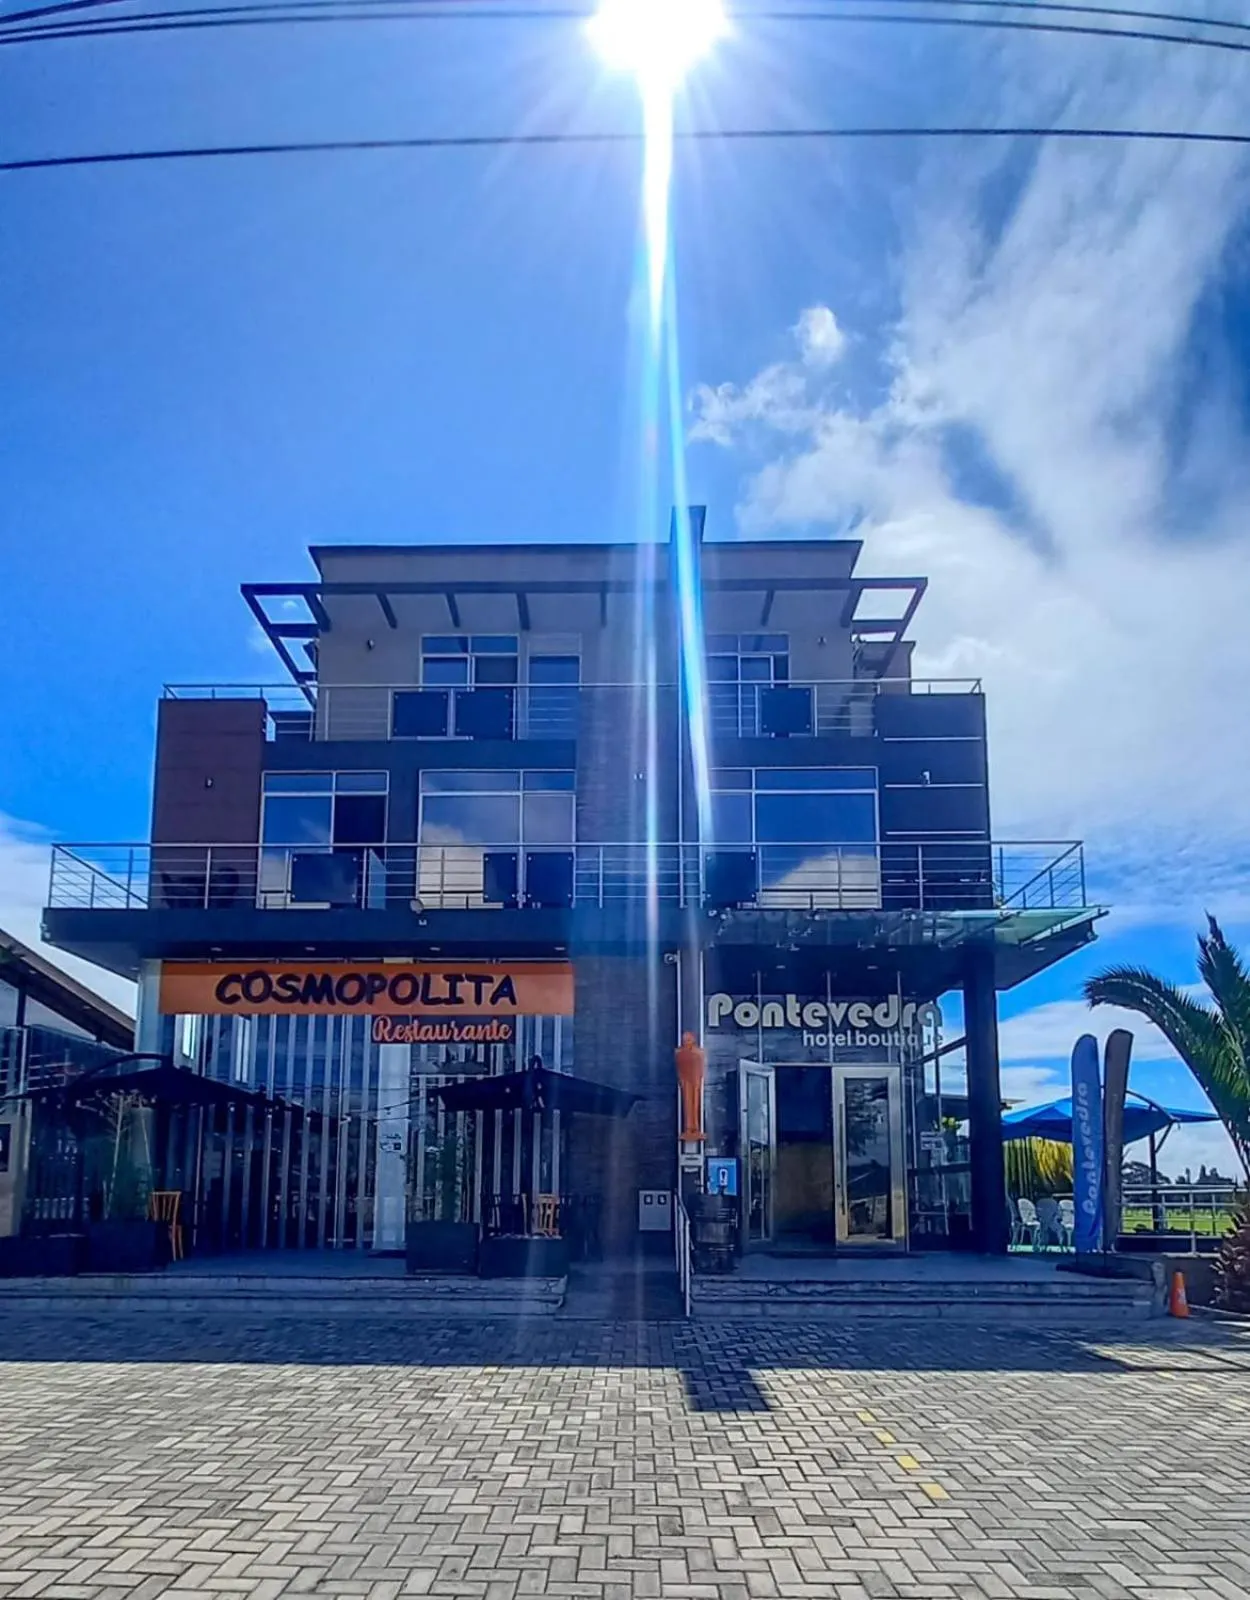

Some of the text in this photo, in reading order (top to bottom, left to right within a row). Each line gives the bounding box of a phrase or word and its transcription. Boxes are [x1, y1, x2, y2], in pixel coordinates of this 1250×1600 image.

[215, 970, 517, 1006] COSMOPOLITA
[708, 993, 943, 1028] Pontevedra
[373, 1016, 511, 1042] Restaurante
[803, 1030, 852, 1047] hotel
